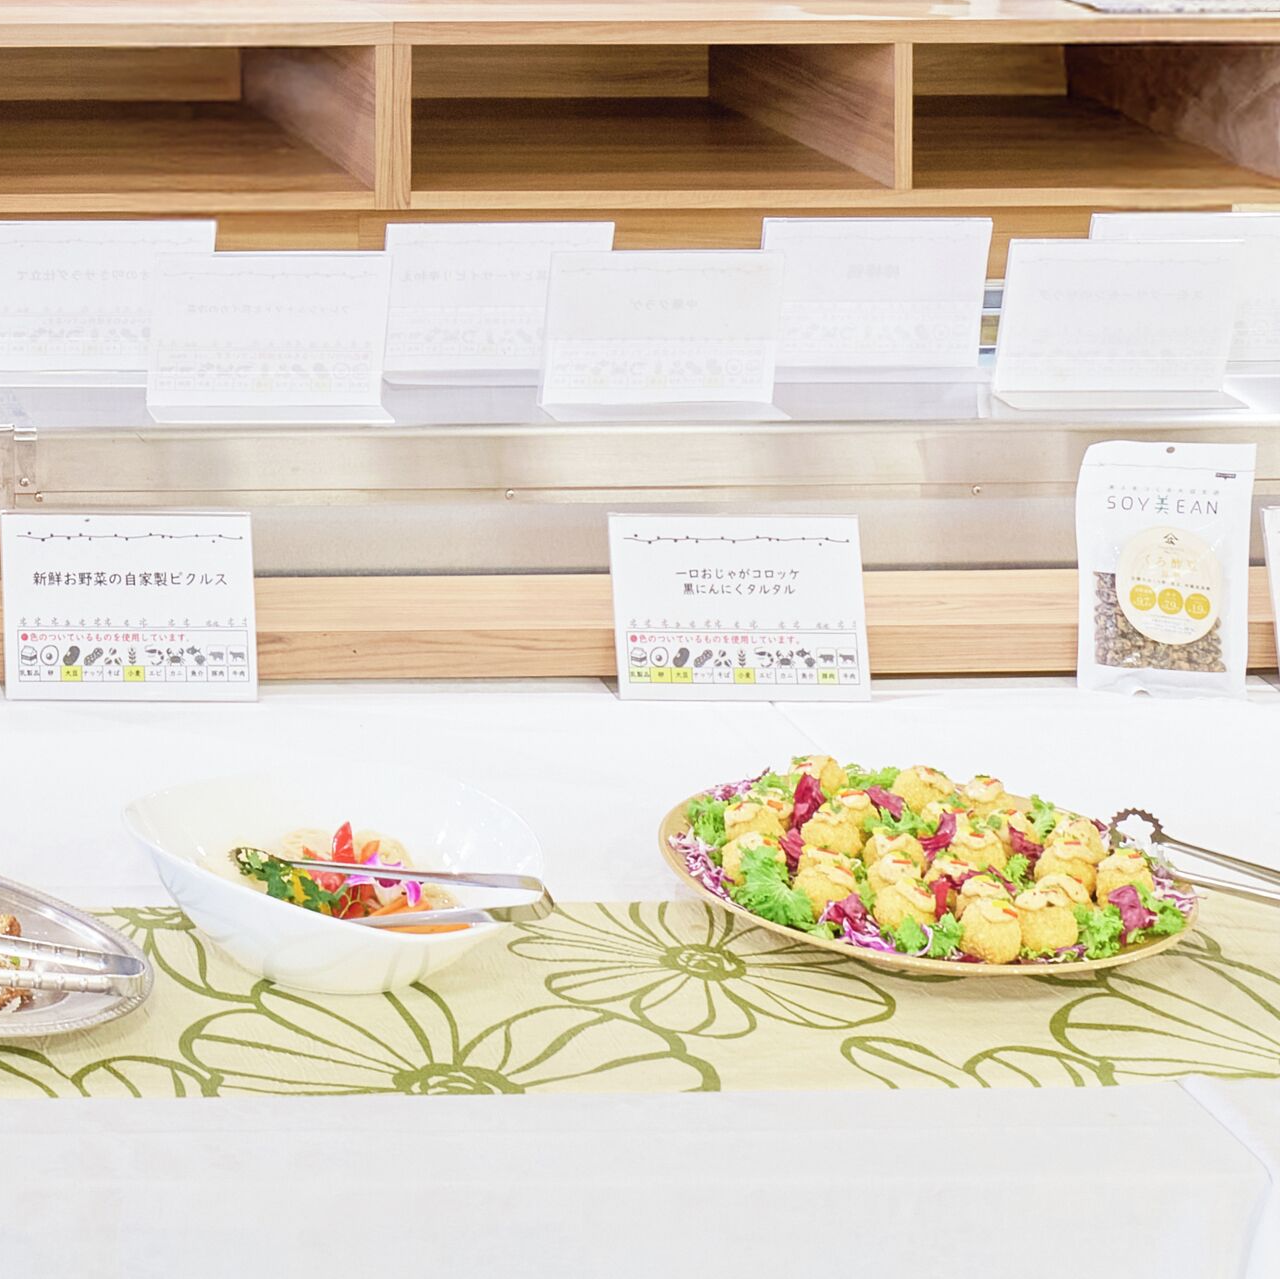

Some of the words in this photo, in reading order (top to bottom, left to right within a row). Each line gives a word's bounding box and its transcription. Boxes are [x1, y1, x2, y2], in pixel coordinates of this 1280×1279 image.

[32, 571, 228, 587] 新鮮お野菜の自家製ピクルス
[675, 567, 800, 580] 一口おじゃがコロッケ
[683, 582, 796, 596] 黒にんにくタルタル
